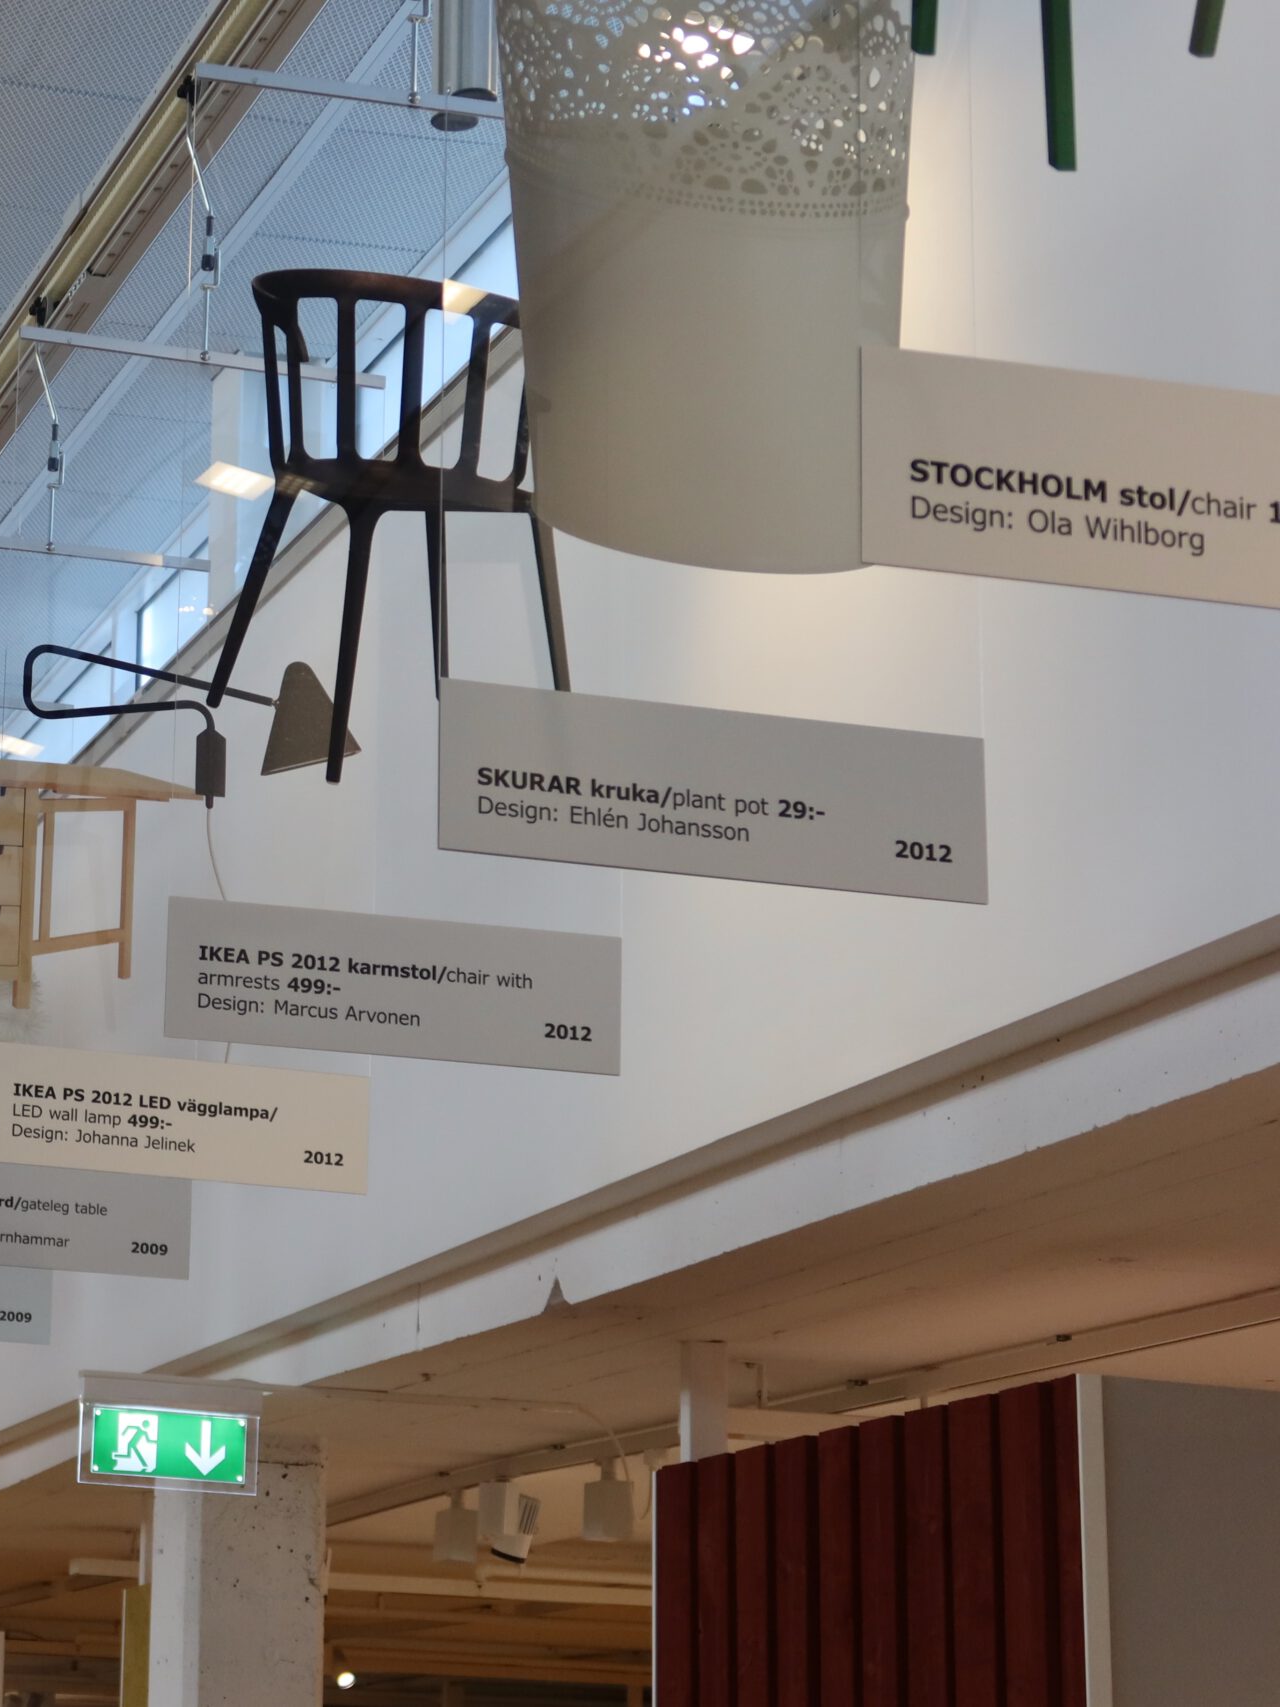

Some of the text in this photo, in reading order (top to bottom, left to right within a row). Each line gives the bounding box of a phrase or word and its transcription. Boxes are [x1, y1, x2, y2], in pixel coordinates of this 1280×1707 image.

[910, 458, 1107, 503] STOCKHOLM
[1119, 484, 1257, 521] stol/chair
[910, 496, 1204, 556] Design: Ola Wihlborg
[477, 767, 825, 820] SKURAR kruka/plant pot 29:-
[478, 796, 750, 842] Design: Ehlén Johansson
[894, 840, 952, 863] 2012
[199, 945, 533, 989] IKEA PS 2012 karmstol/chair with
[198, 972, 341, 995] armrests 499:-
[197, 994, 420, 1027] Design: Marcus Arvonen
[544, 1023, 592, 1041] 2012
[12, 1103, 172, 1129] LED wall lamp 499:-
[13, 1083, 278, 1122] IKEA PS 2012 LED vägglampa/
[12, 1124, 195, 1152] Design: Johanna Jelinek
[303, 1151, 343, 1166] 2012
[75, 1202, 107, 1216] table
[131, 1242, 168, 1255] 2009
[0, 1310, 32, 1323] 2009
